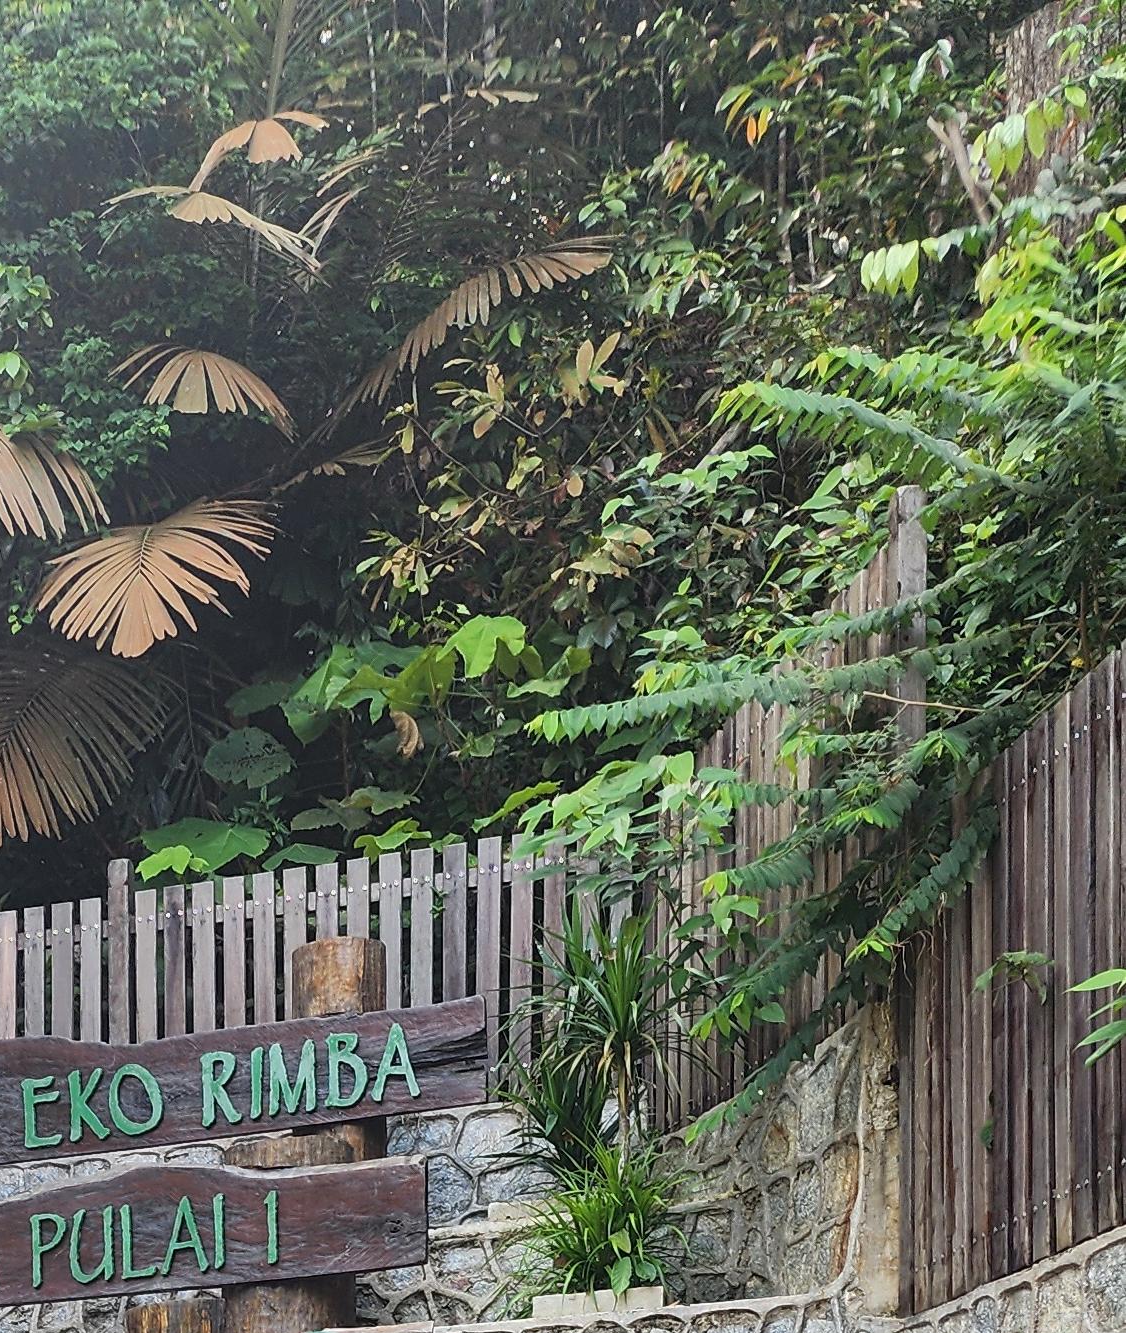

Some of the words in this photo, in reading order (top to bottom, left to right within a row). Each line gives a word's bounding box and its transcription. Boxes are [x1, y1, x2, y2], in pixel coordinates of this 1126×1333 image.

[21, 1063, 164, 1149] EKO
[200, 1022, 421, 1128] RIMBA
[29, 1192, 226, 1288] PULAI
[263, 1189, 279, 1265] 1
